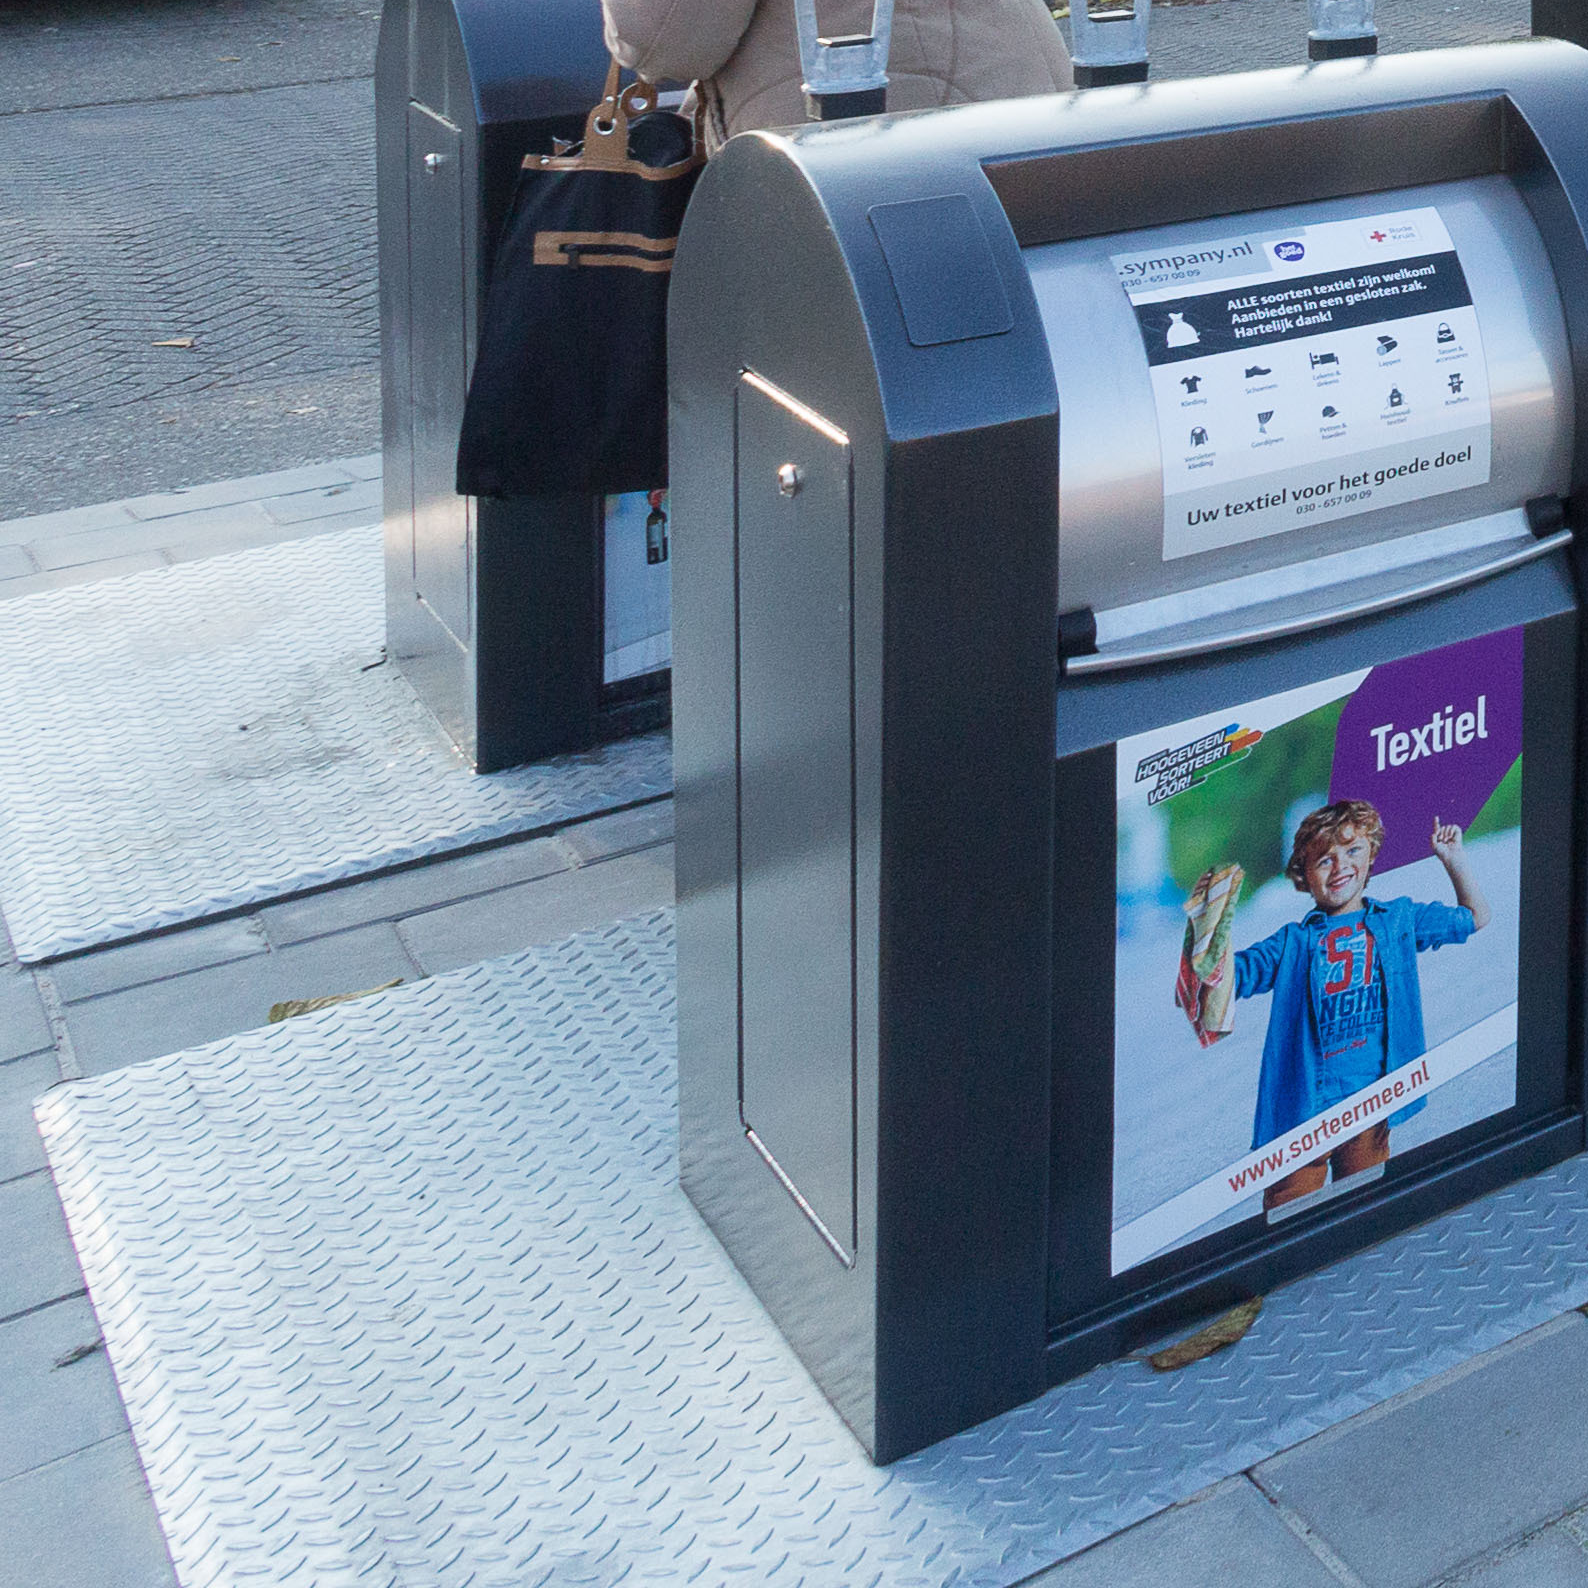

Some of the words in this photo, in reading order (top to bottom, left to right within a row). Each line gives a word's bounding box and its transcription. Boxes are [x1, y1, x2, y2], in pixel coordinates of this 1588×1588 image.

[1118, 241, 1254, 276] .sympany.nl
[1227, 296, 1259, 311] ALLE
[1260, 287, 1312, 305] soorten
[1312, 278, 1355, 298] textiel
[1357, 271, 1382, 290] zijn
[1382, 263, 1436, 284] welkom!
[1231, 302, 1304, 326] Aanbieden
[1304, 297, 1318, 311] in
[1319, 295, 1344, 309] een
[1345, 283, 1400, 306] gesloten
[1400, 279, 1428, 295] zak.
[1234, 315, 1294, 340] Hartelijk
[1295, 310, 1333, 327] dank!
[1187, 508, 1220, 527] Uw
[1224, 488, 1288, 518] textiel
[1291, 479, 1337, 502] voor
[1339, 471, 1370, 491] het
[1373, 457, 1431, 487] goede
[1434, 445, 1473, 469] doel
[1296, 502, 1316, 515] 030
[1323, 496, 1343, 509] 657
[1344, 492, 1358, 503] 00
[1358, 489, 1373, 500] 09
[1137, 730, 1226, 781] HOOGEVEEN
[1370, 695, 1489, 772] Textiel
[1158, 742, 1232, 786] SORTEERT
[1228, 1060, 1431, 1193] www.sorteermee.nl
